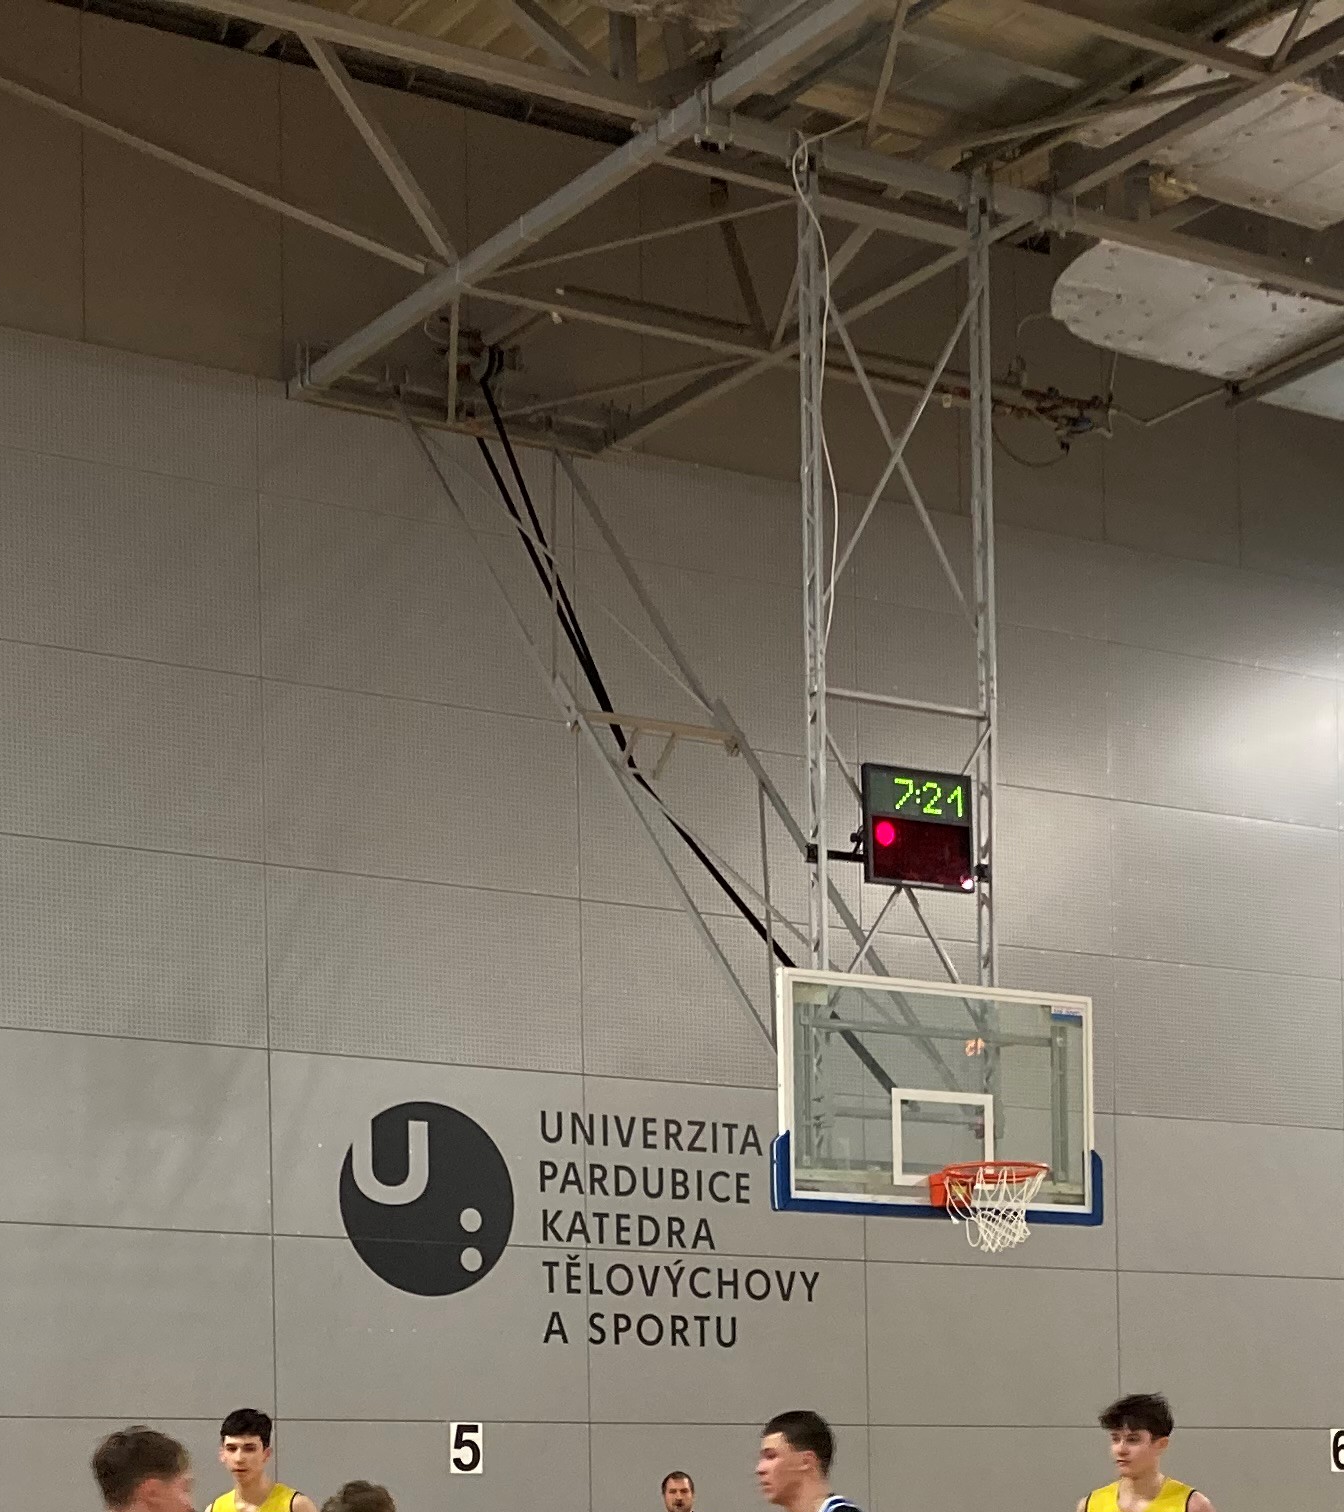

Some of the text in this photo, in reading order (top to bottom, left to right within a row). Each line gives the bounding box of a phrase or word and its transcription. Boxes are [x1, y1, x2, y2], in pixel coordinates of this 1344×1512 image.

[894, 777, 963, 817] 7:21
[540, 1110, 763, 1156] UNIVERZITA
[539, 1160, 750, 1204] PARDUBICE
[542, 1209, 716, 1250] KATEDRA
[542, 1254, 820, 1302] TĚLOVÝCHOVY
[543, 1311, 737, 1348] A SPORTU
[453, 1424, 481, 1472] 5
